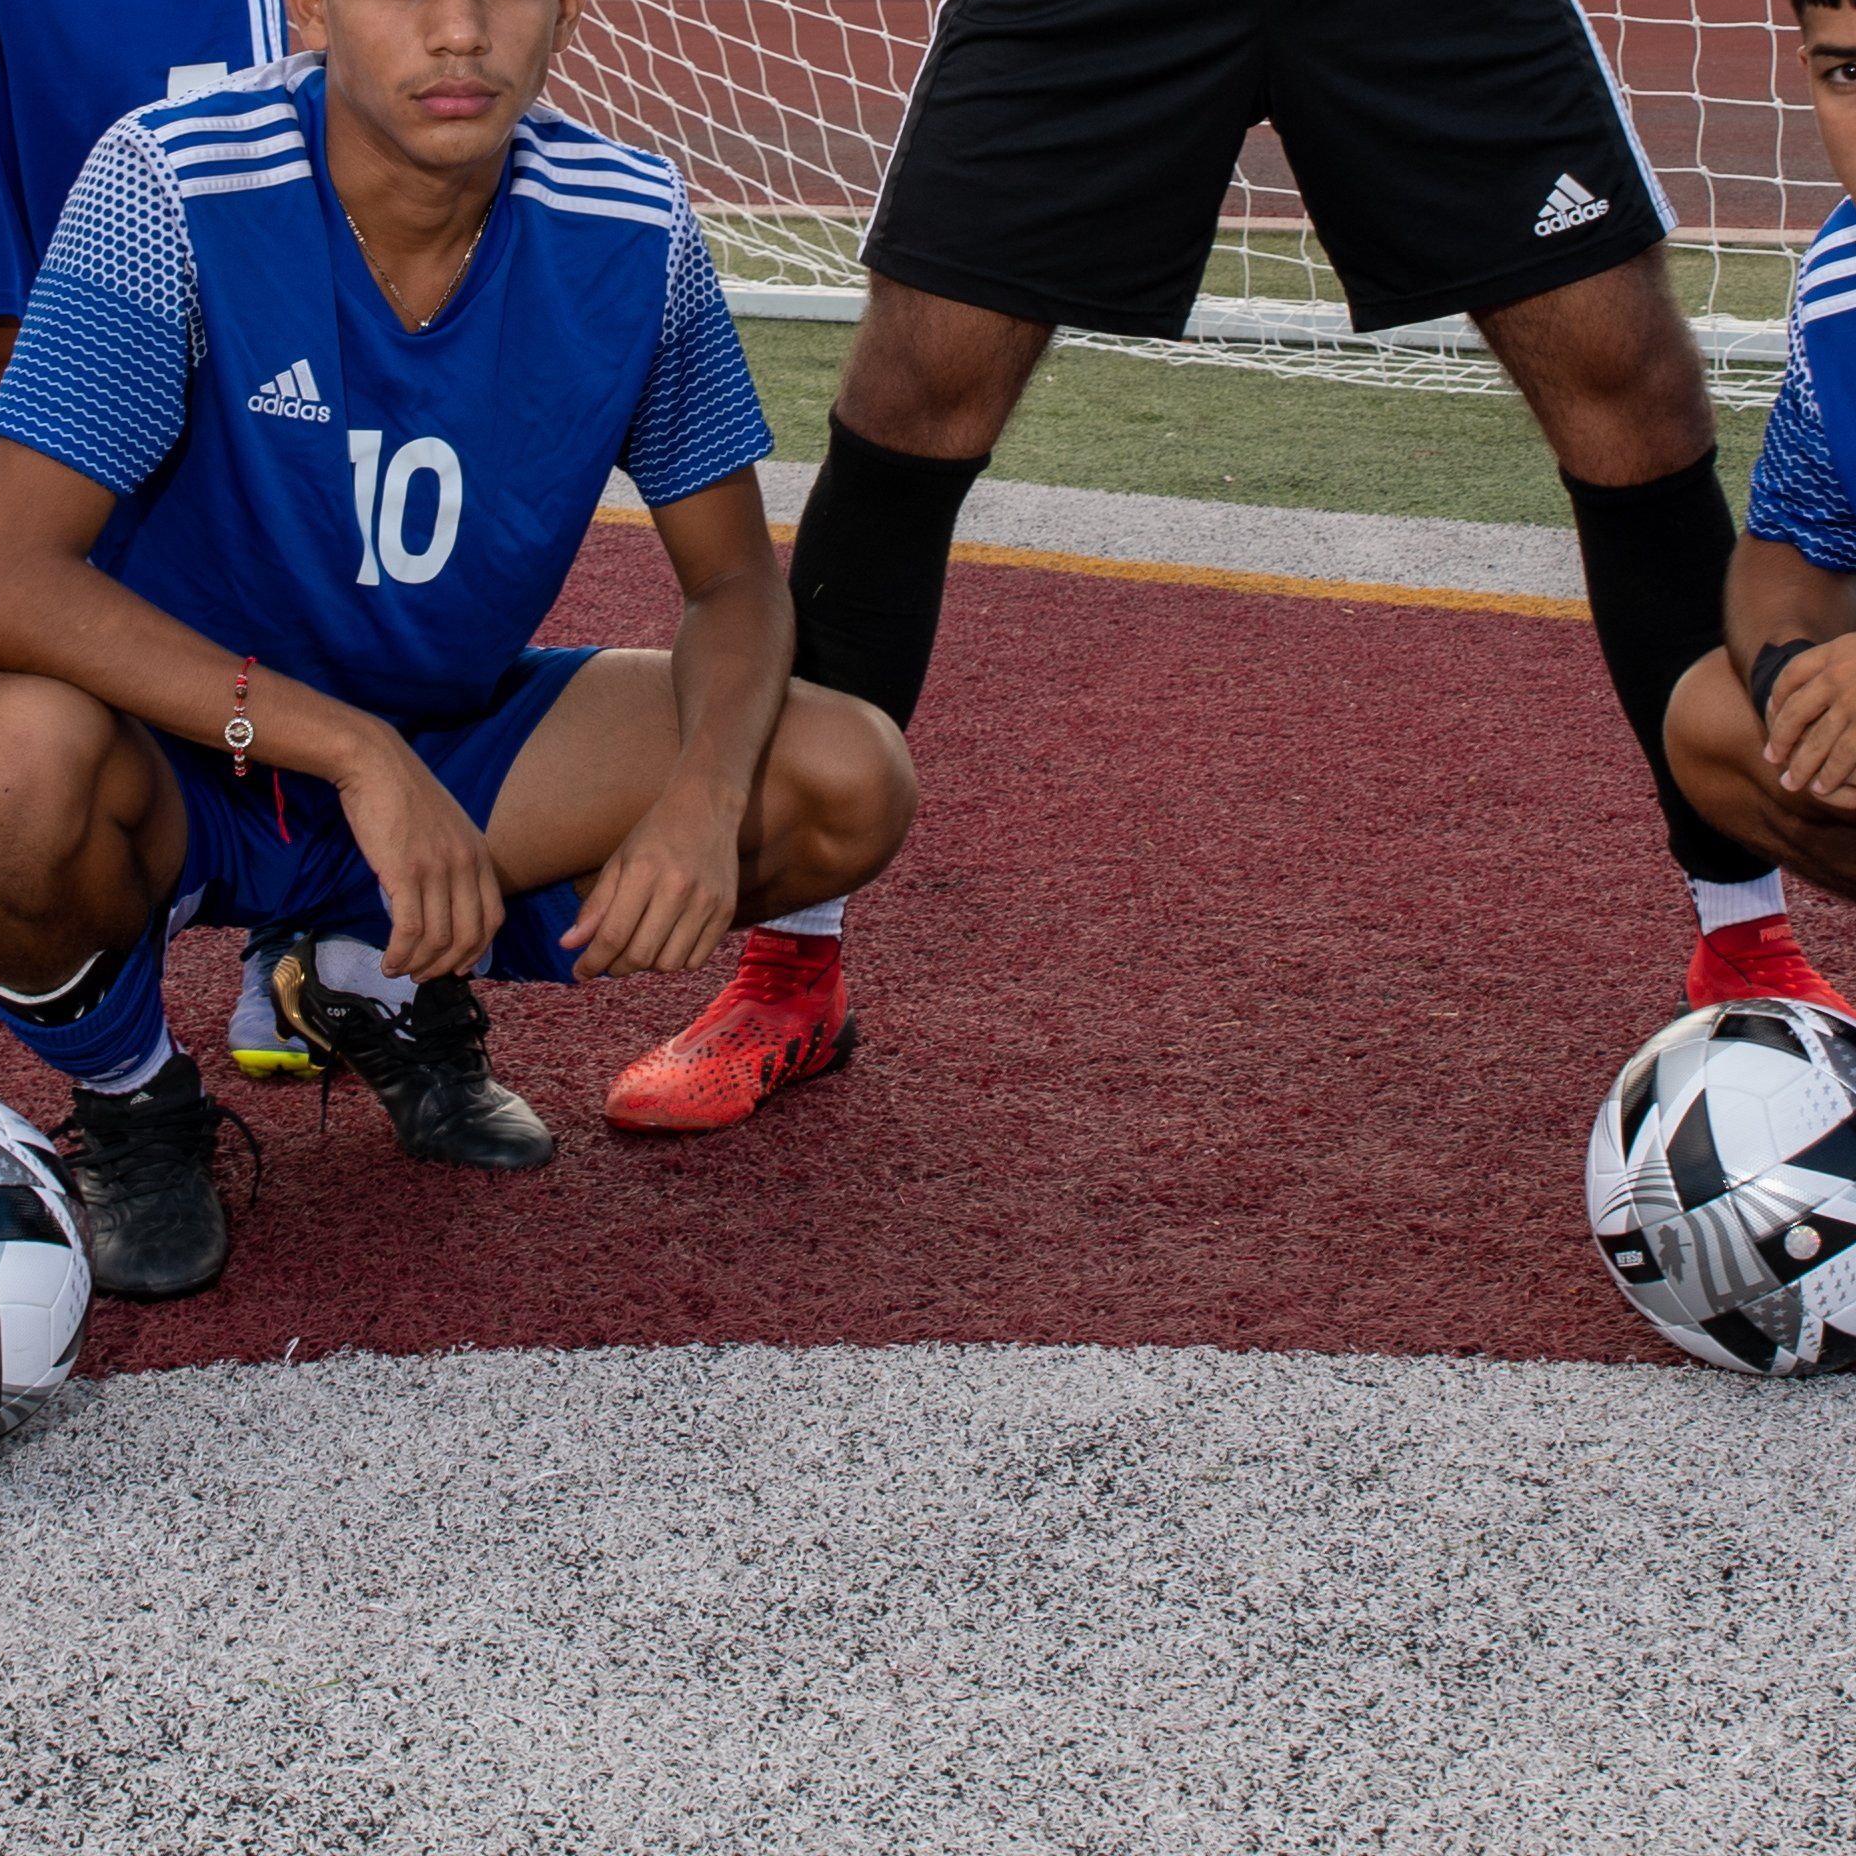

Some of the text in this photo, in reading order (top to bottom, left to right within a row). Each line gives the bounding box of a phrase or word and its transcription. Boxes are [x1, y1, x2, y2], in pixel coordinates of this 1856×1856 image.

[1534, 199, 1609, 237] adidas
[247, 394, 331, 423] adidas
[347, 430, 463, 585] 10
